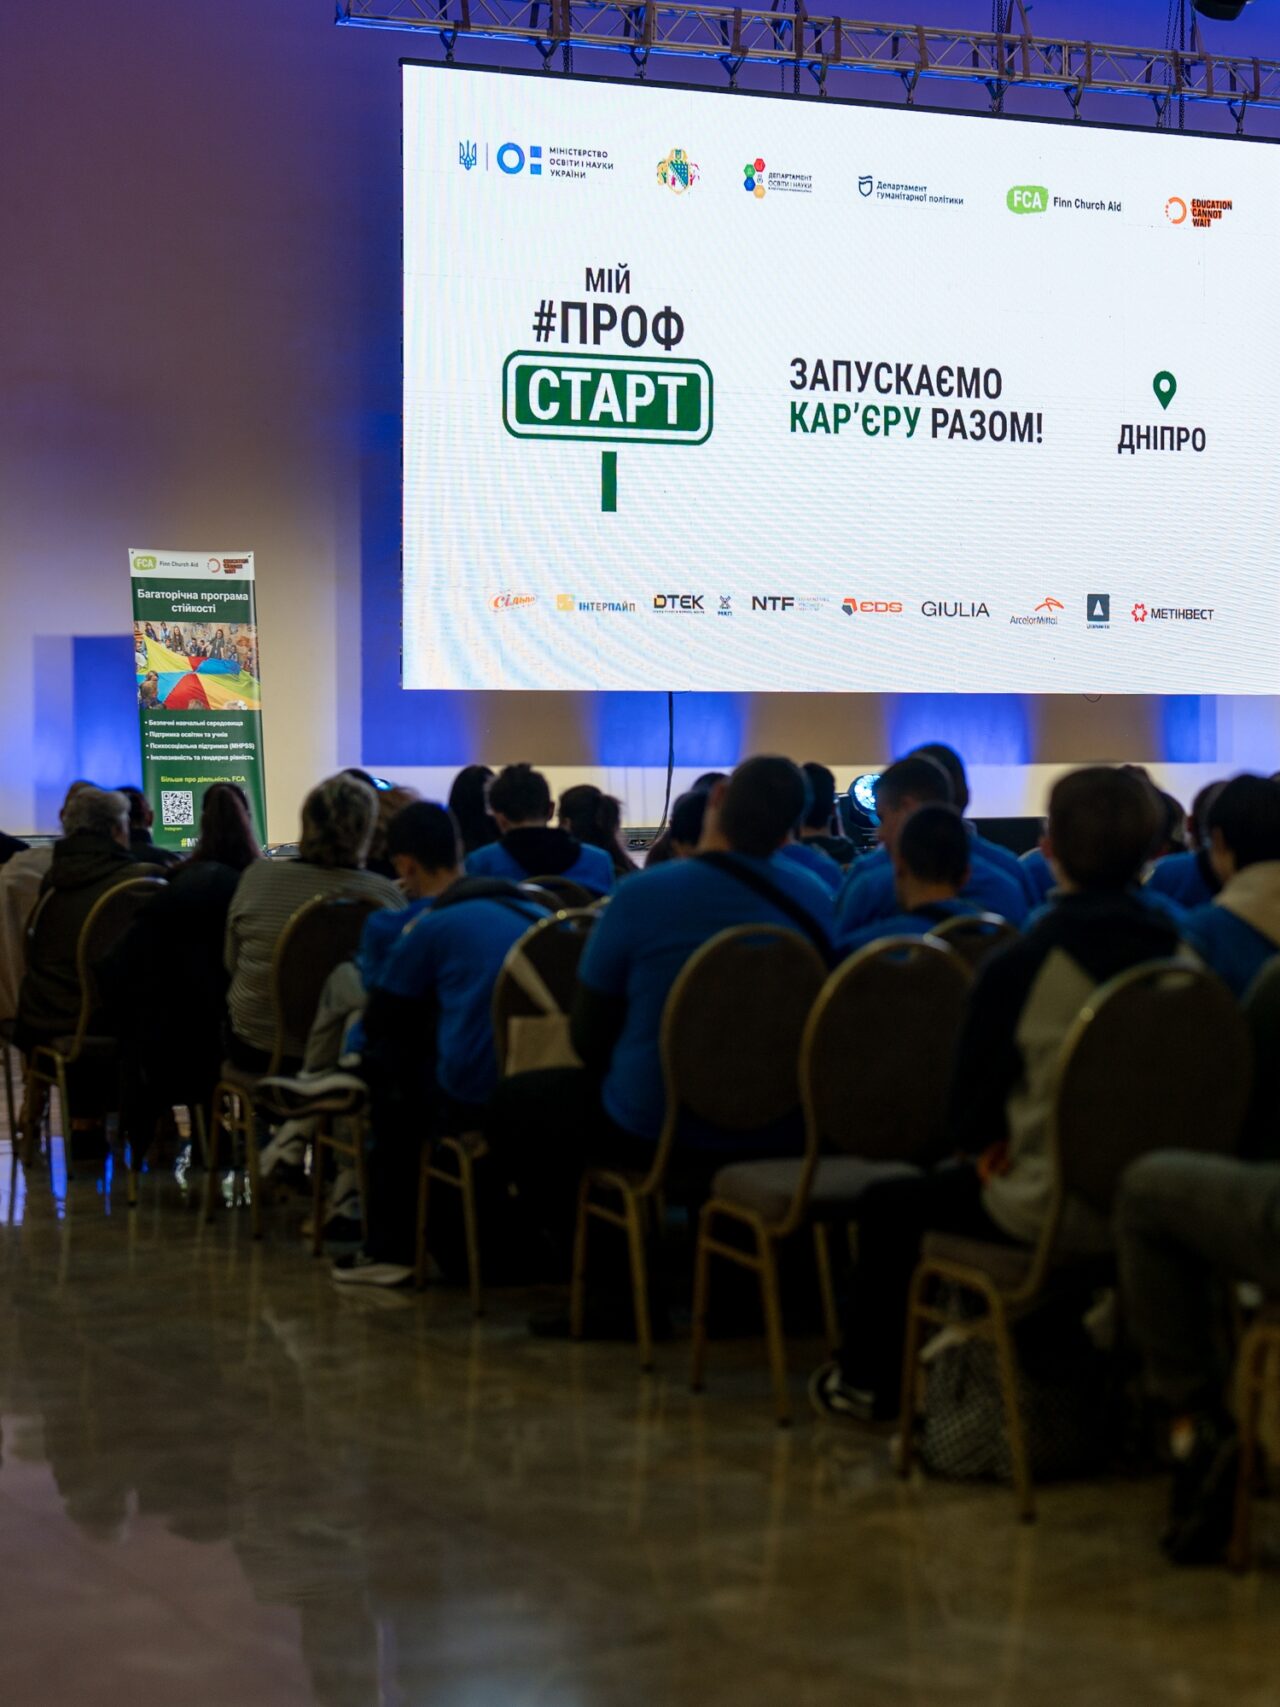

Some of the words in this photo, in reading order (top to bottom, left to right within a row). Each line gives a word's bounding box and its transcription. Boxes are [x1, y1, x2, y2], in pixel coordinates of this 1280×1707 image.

[549, 146, 608, 158] МІНІСТЕРСТВО
[549, 158, 580, 168] ОСВІТИ
[586, 160, 614, 170] НАУКИ
[550, 169, 586, 178] УКРАЇНИ
[768, 172, 812, 181] ДЕПАРТАМЕНТ
[876, 181, 927, 192] Департамент
[876, 191, 927, 202] гуманітарної
[929, 195, 964, 205] політики
[1013, 190, 1042, 209] FCA
[1054, 196, 1072, 208] Finn
[1074, 198, 1106, 211] Church
[1108, 200, 1122, 212] Aid
[1192, 199, 1233, 210] EDUCATION
[1192, 208, 1222, 219] CANNOT
[1192, 218, 1211, 228] WAIT
[585, 262, 631, 294] МІЙ
[532, 300, 685, 351] #ПРОФ
[790, 357, 1003, 400] ЗАПУСКАЄМО
[528, 368, 688, 425] СТАРТ
[931, 407, 1043, 444] РАЗОМ!
[1117, 424, 1206, 455] ДНІПРО
[136, 559, 154, 568] FCA
[137, 589, 198, 601] Багаторічна
[200, 592, 249, 602] програма
[171, 603, 216, 613] стійкості
[579, 601, 636, 612] ІНТЕРПАЙП
[653, 594, 704, 610] DTEK
[752, 596, 795, 611] NTF
[860, 601, 903, 613] EDS
[921, 600, 990, 618] GIULIA
[1151, 608, 1215, 620] МЕТІНВЕСТ
